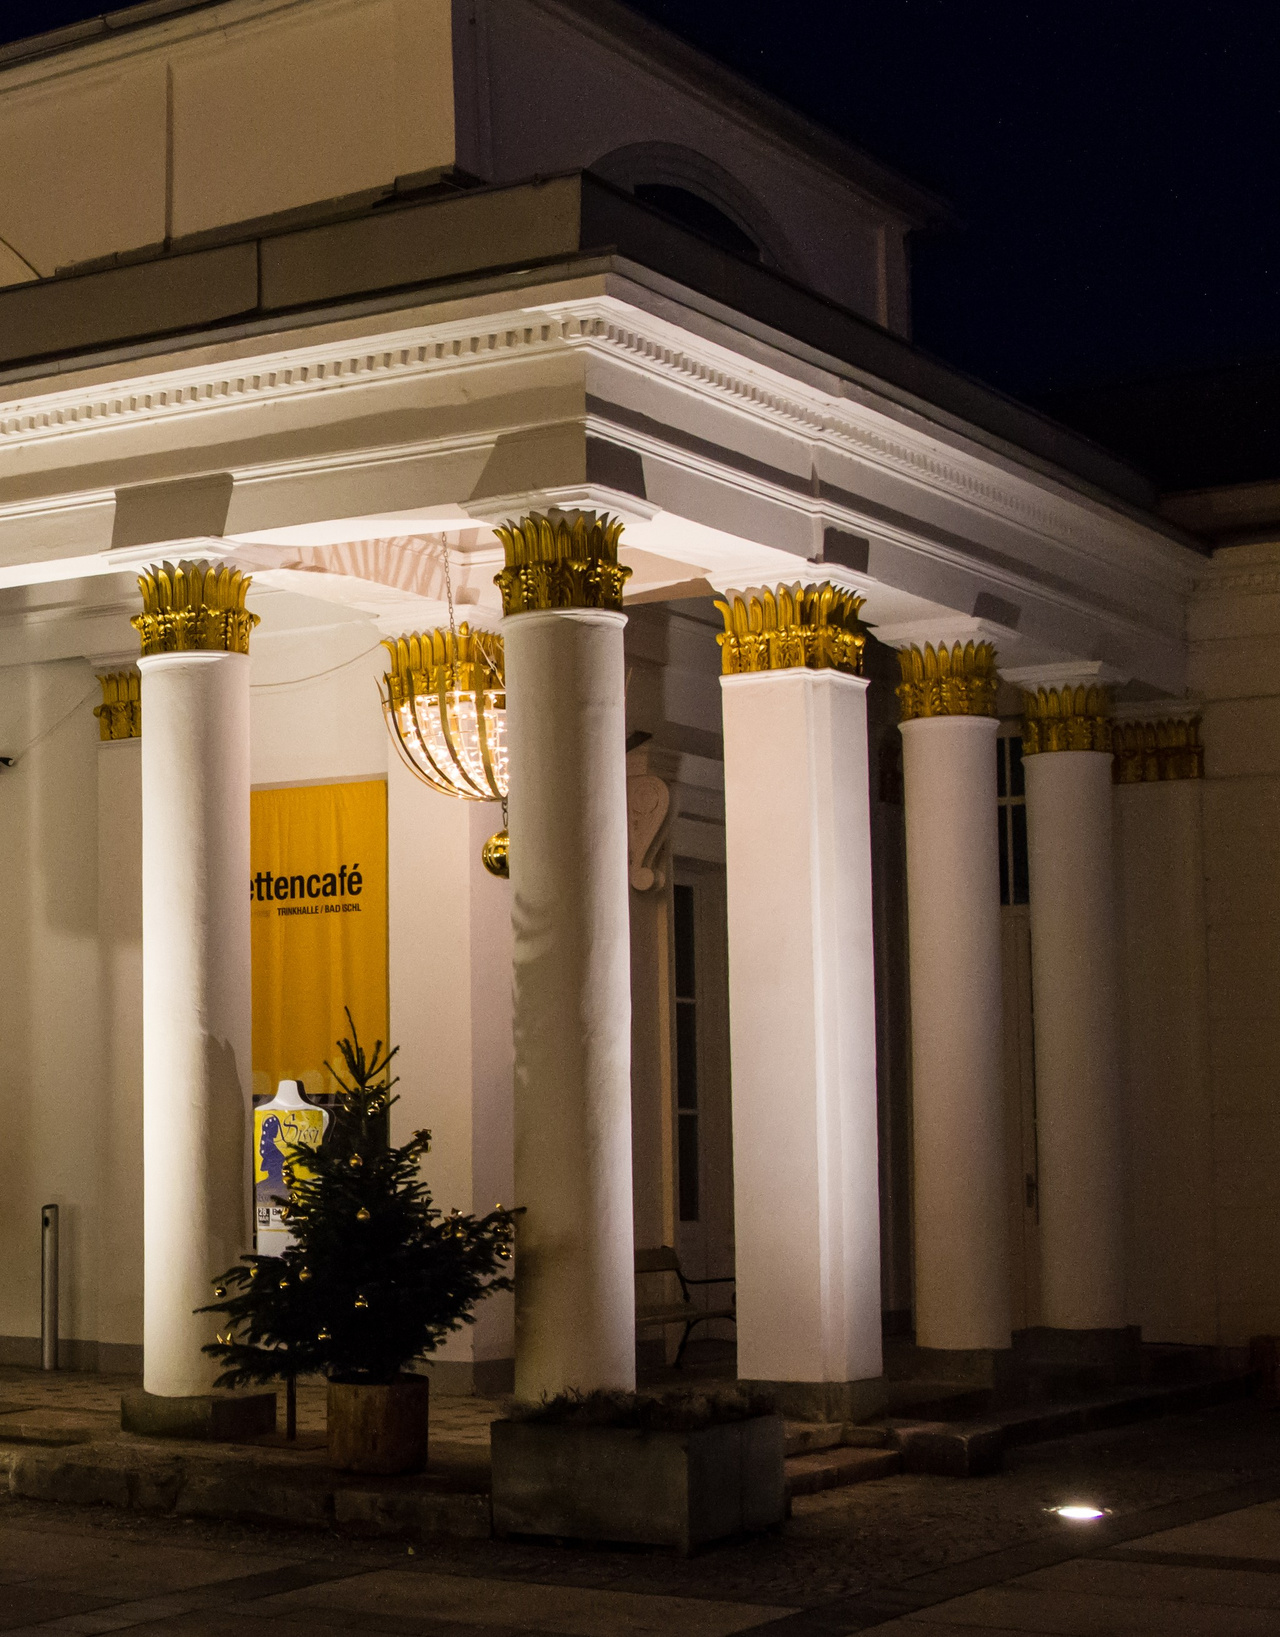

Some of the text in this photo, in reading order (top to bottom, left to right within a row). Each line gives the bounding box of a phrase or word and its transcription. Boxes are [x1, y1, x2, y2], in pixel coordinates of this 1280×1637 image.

[250, 863, 363, 901] ttencafé
[277, 905, 319, 916] TRINKHALLE
[325, 903, 341, 914] BAD
[342, 903, 362, 913] ISCHL
